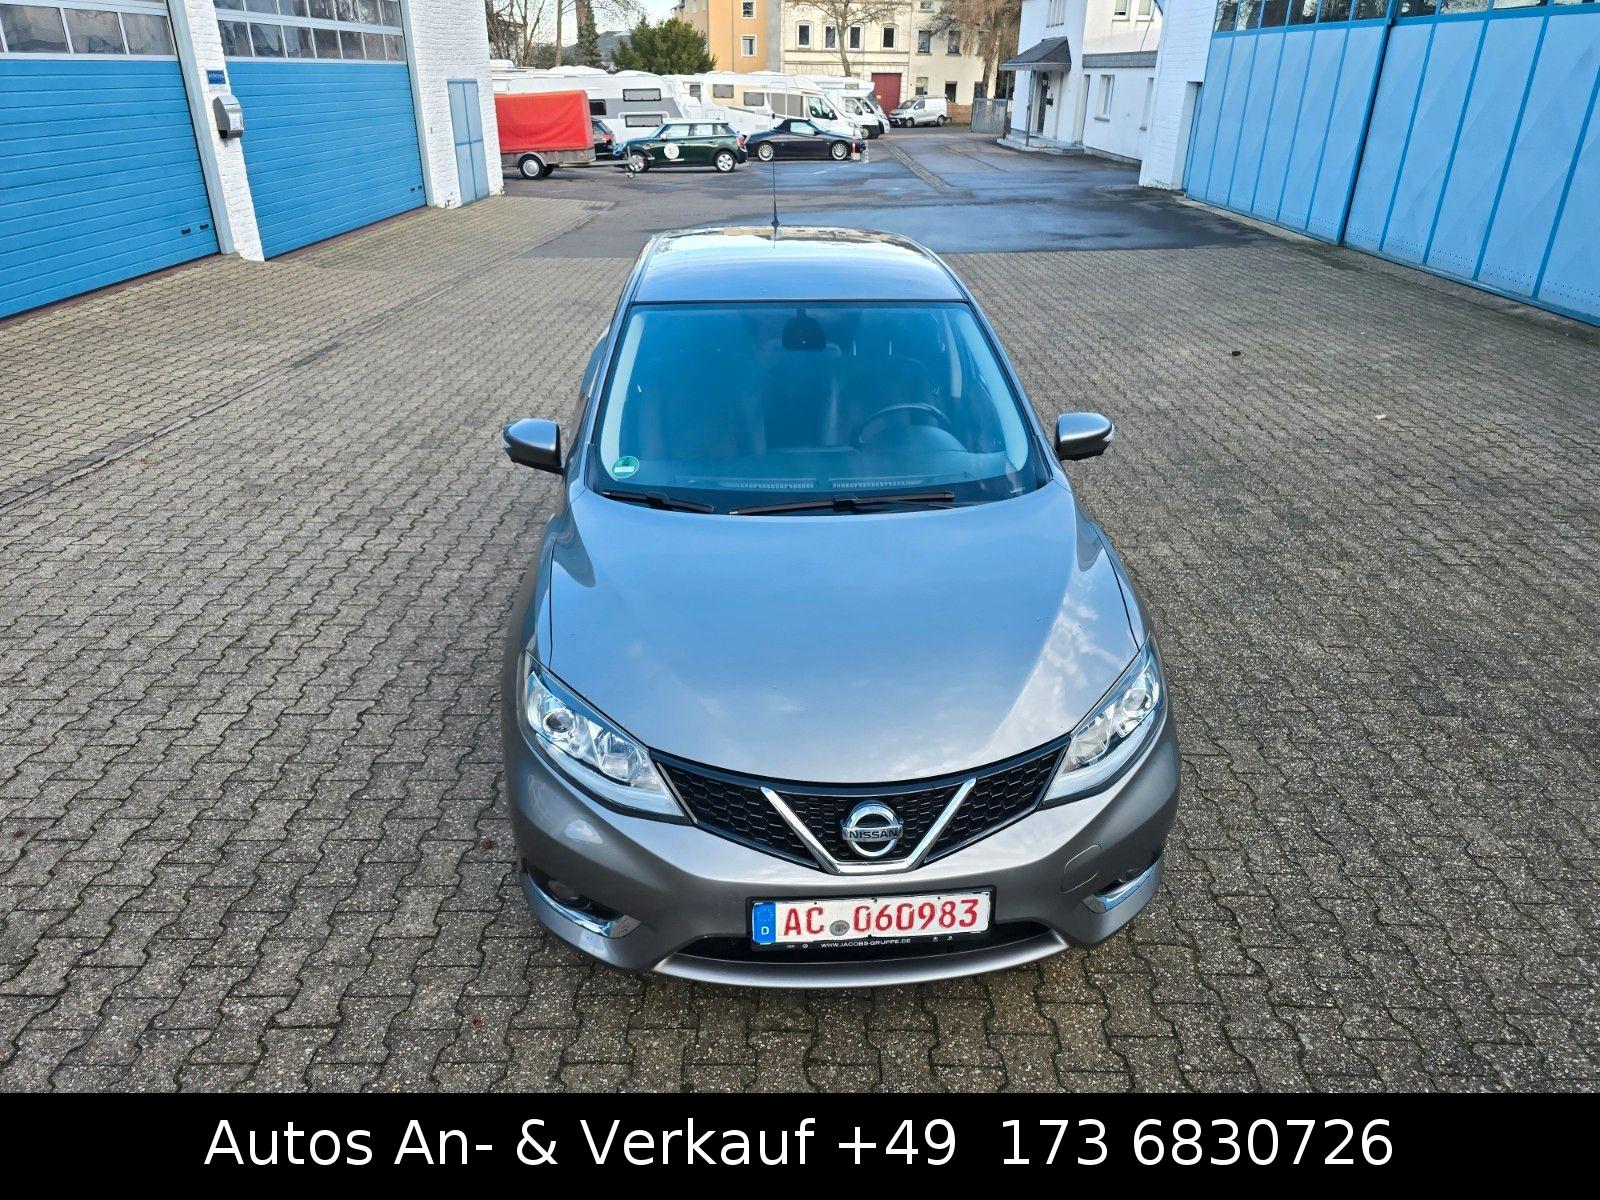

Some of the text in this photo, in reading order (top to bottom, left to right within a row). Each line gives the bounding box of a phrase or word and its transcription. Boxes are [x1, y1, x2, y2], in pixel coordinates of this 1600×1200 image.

[849, 830, 897, 839] NISSAN
[783, 898, 979, 936] AC 060983
[761, 926, 770, 936] D
